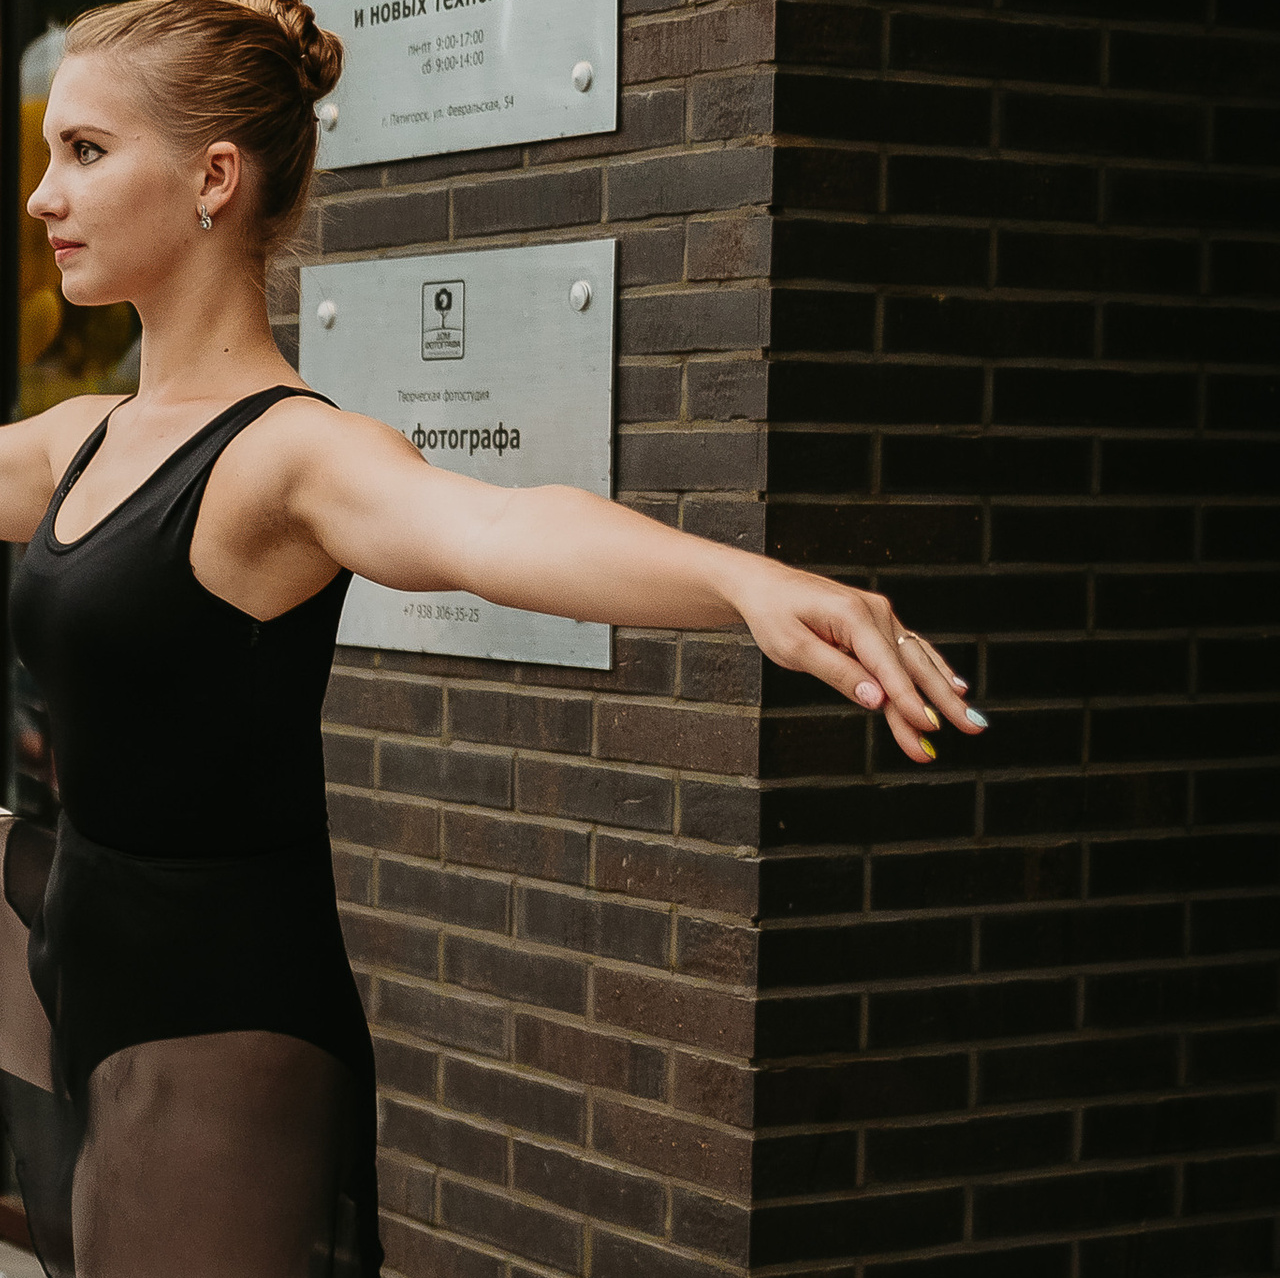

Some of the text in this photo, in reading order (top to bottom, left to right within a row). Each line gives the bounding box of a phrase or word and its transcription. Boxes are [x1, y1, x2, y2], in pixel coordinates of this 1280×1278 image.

[354, 8, 365, 29] и
[435, 29, 484, 52] 9:00-17:00
[435, 50, 484, 73] 9:00-14:00
[411, 421, 520, 457] фотографа
